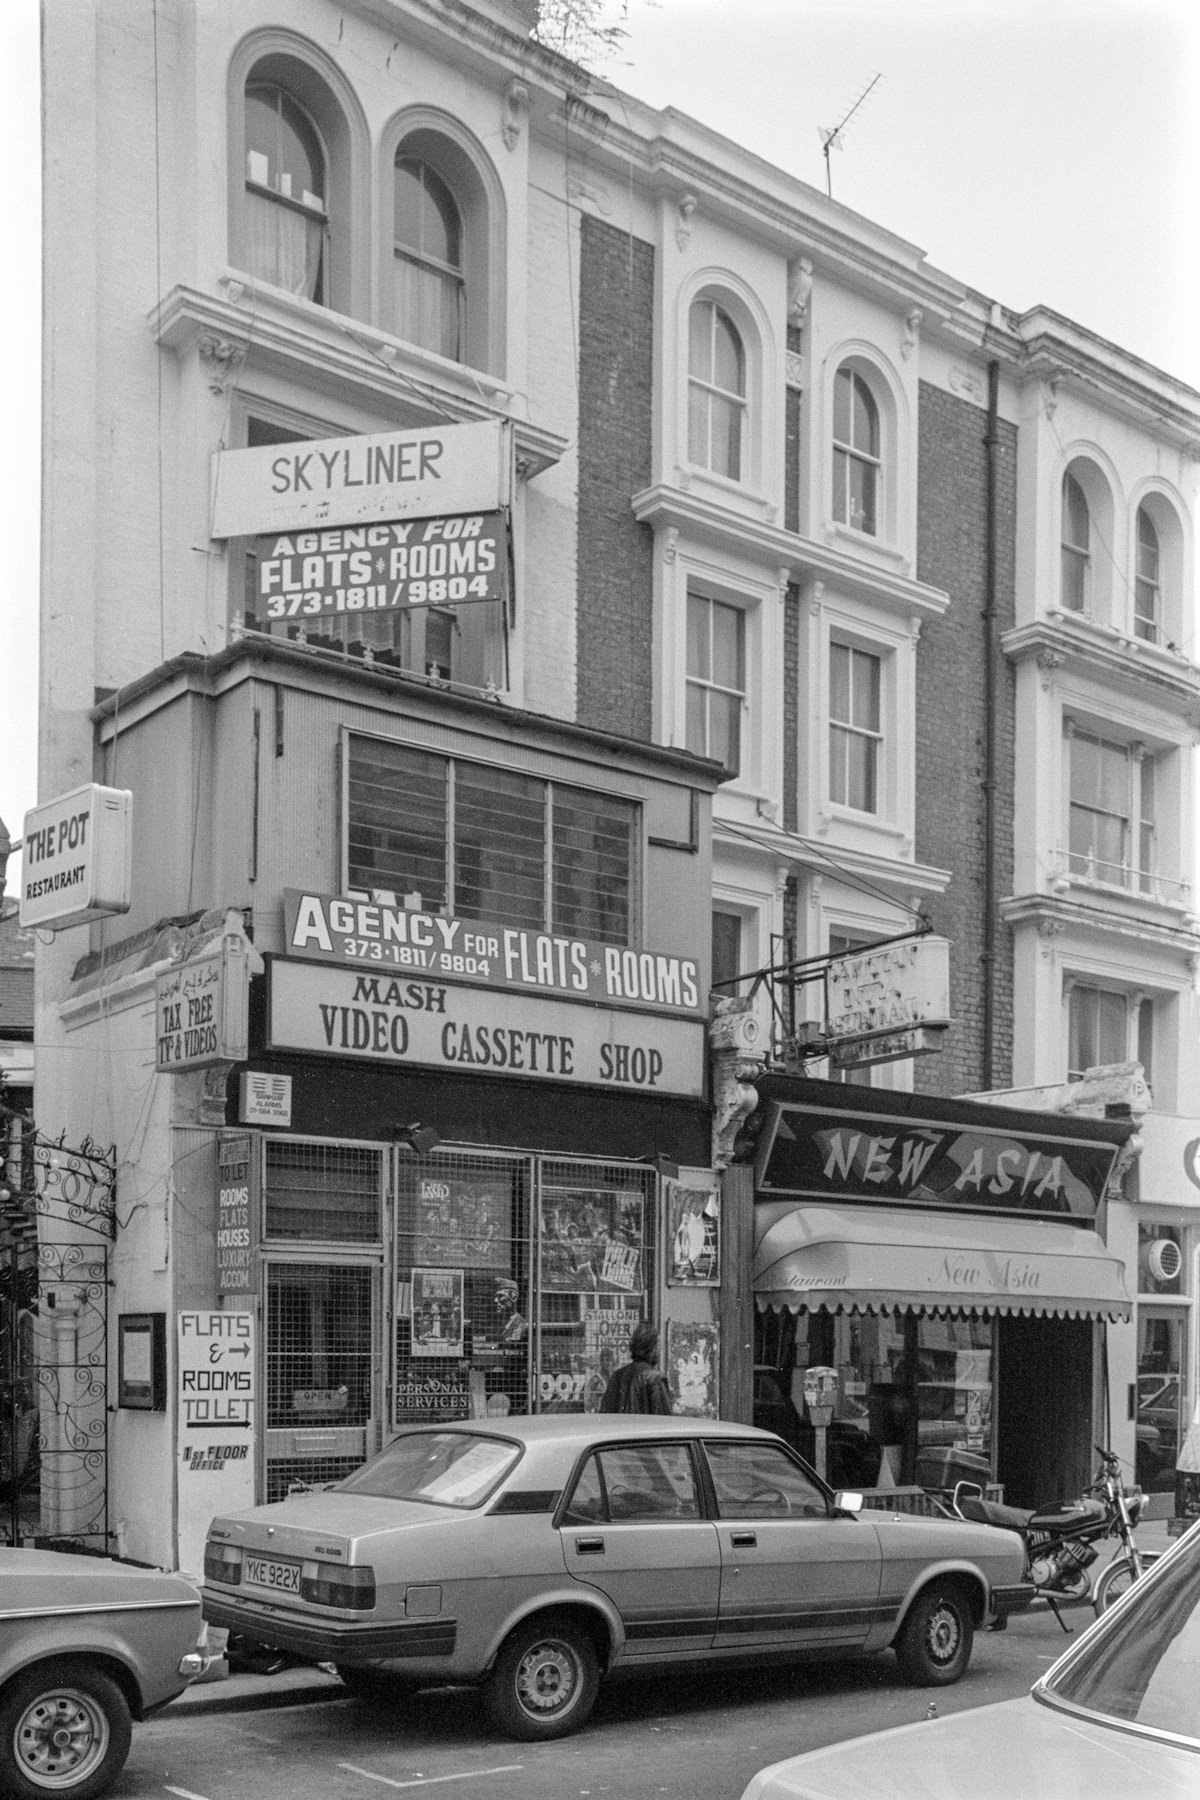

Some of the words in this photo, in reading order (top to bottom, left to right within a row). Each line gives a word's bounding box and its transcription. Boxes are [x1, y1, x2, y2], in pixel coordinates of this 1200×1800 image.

[271, 439, 444, 493] SKYLINER
[272, 522, 415, 557] AGENCY
[422, 516, 485, 542] FOR
[260, 551, 372, 594] FLATS
[389, 538, 496, 580] ROOMS
[27, 825, 55, 865] THE
[58, 811, 90, 854] POT
[26, 865, 86, 900] RESTAURANT
[292, 895, 461, 951] AGENCY
[463, 933, 499, 958] FOR
[503, 929, 588, 991] FLATS
[605, 947, 698, 1008] ROOMS
[352, 976, 448, 1013] MASH
[163, 1003, 182, 1034] TAX
[188, 994, 214, 1028] FREE
[175, 1033, 182, 1061] &
[184, 1024, 218, 1059] VIDEOS
[318, 1003, 409, 1055] VIDEO
[441, 1021, 575, 1075] CASSETTE
[599, 1042, 664, 1086] SHOP
[220, 1165, 230, 1182] TO
[233, 1162, 249, 1180] LET
[823, 1130, 938, 1187] NEW
[954, 1148, 1063, 1200] ASIA
[220, 1187, 249, 1208] ROOMS
[219, 1208, 248, 1228] FLATS
[217, 1229, 250, 1248] HOUSES
[217, 1248, 251, 1268] LUXURY
[928, 1253, 981, 1286] New
[988, 1257, 1041, 1289] Asia
[586, 1309, 639, 1321] STALLONE
[181, 1315, 250, 1337] FLATS
[600, 1320, 632, 1337] OVER
[209, 1343, 226, 1363] &
[183, 1370, 251, 1391] ROOMS
[398, 1379, 467, 1395] PERSONAL
[304, 1391, 332, 1400] OPEN
[397, 1396, 468, 1408] SERVICES
[183, 1399, 209, 1420] TO
[214, 1399, 254, 1419] LET
[207, 1445, 248, 1460] FLOOR
[189, 1460, 226, 1471] OFFICE
[247, 1560, 267, 1582] YKE
[269, 1564, 299, 1590] 922X
